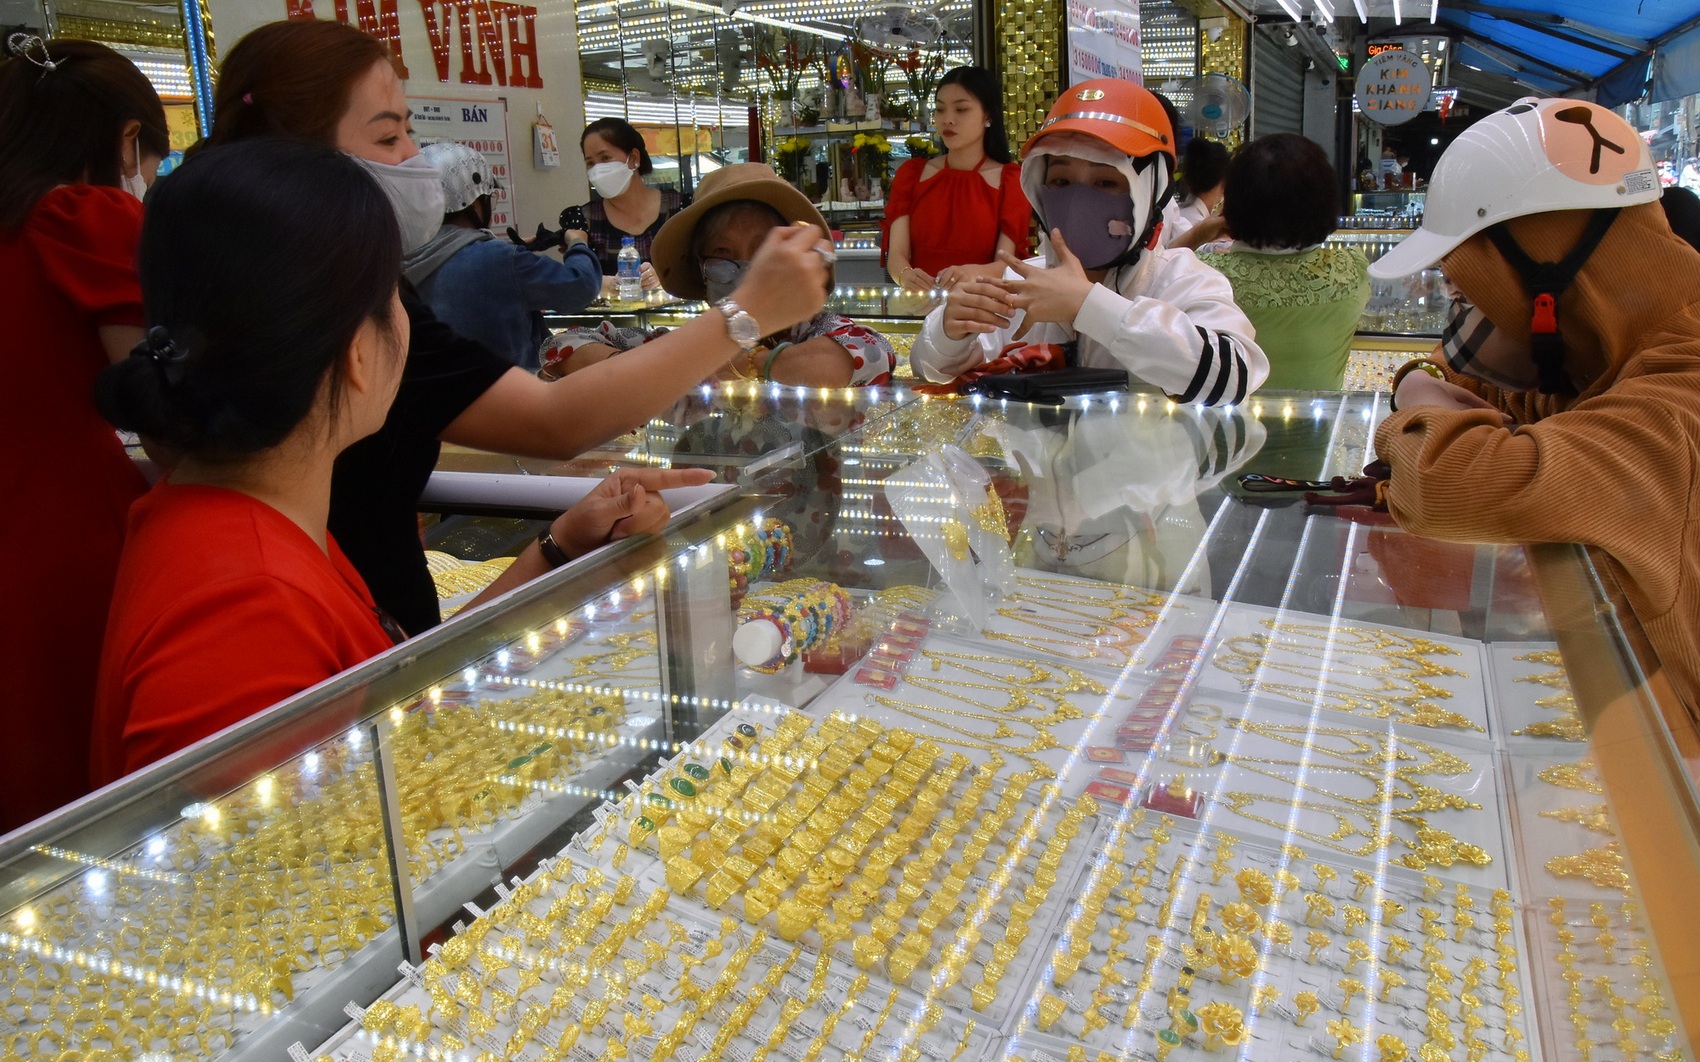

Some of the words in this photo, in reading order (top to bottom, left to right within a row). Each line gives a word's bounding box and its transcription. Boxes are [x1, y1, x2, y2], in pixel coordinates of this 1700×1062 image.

[418, 0, 543, 89] VINH
[1380, 68, 1409, 80] KIM
[1366, 84, 1422, 95] KHANH
[462, 104, 487, 122] BÁN
[541, 133, 557, 152] 31
